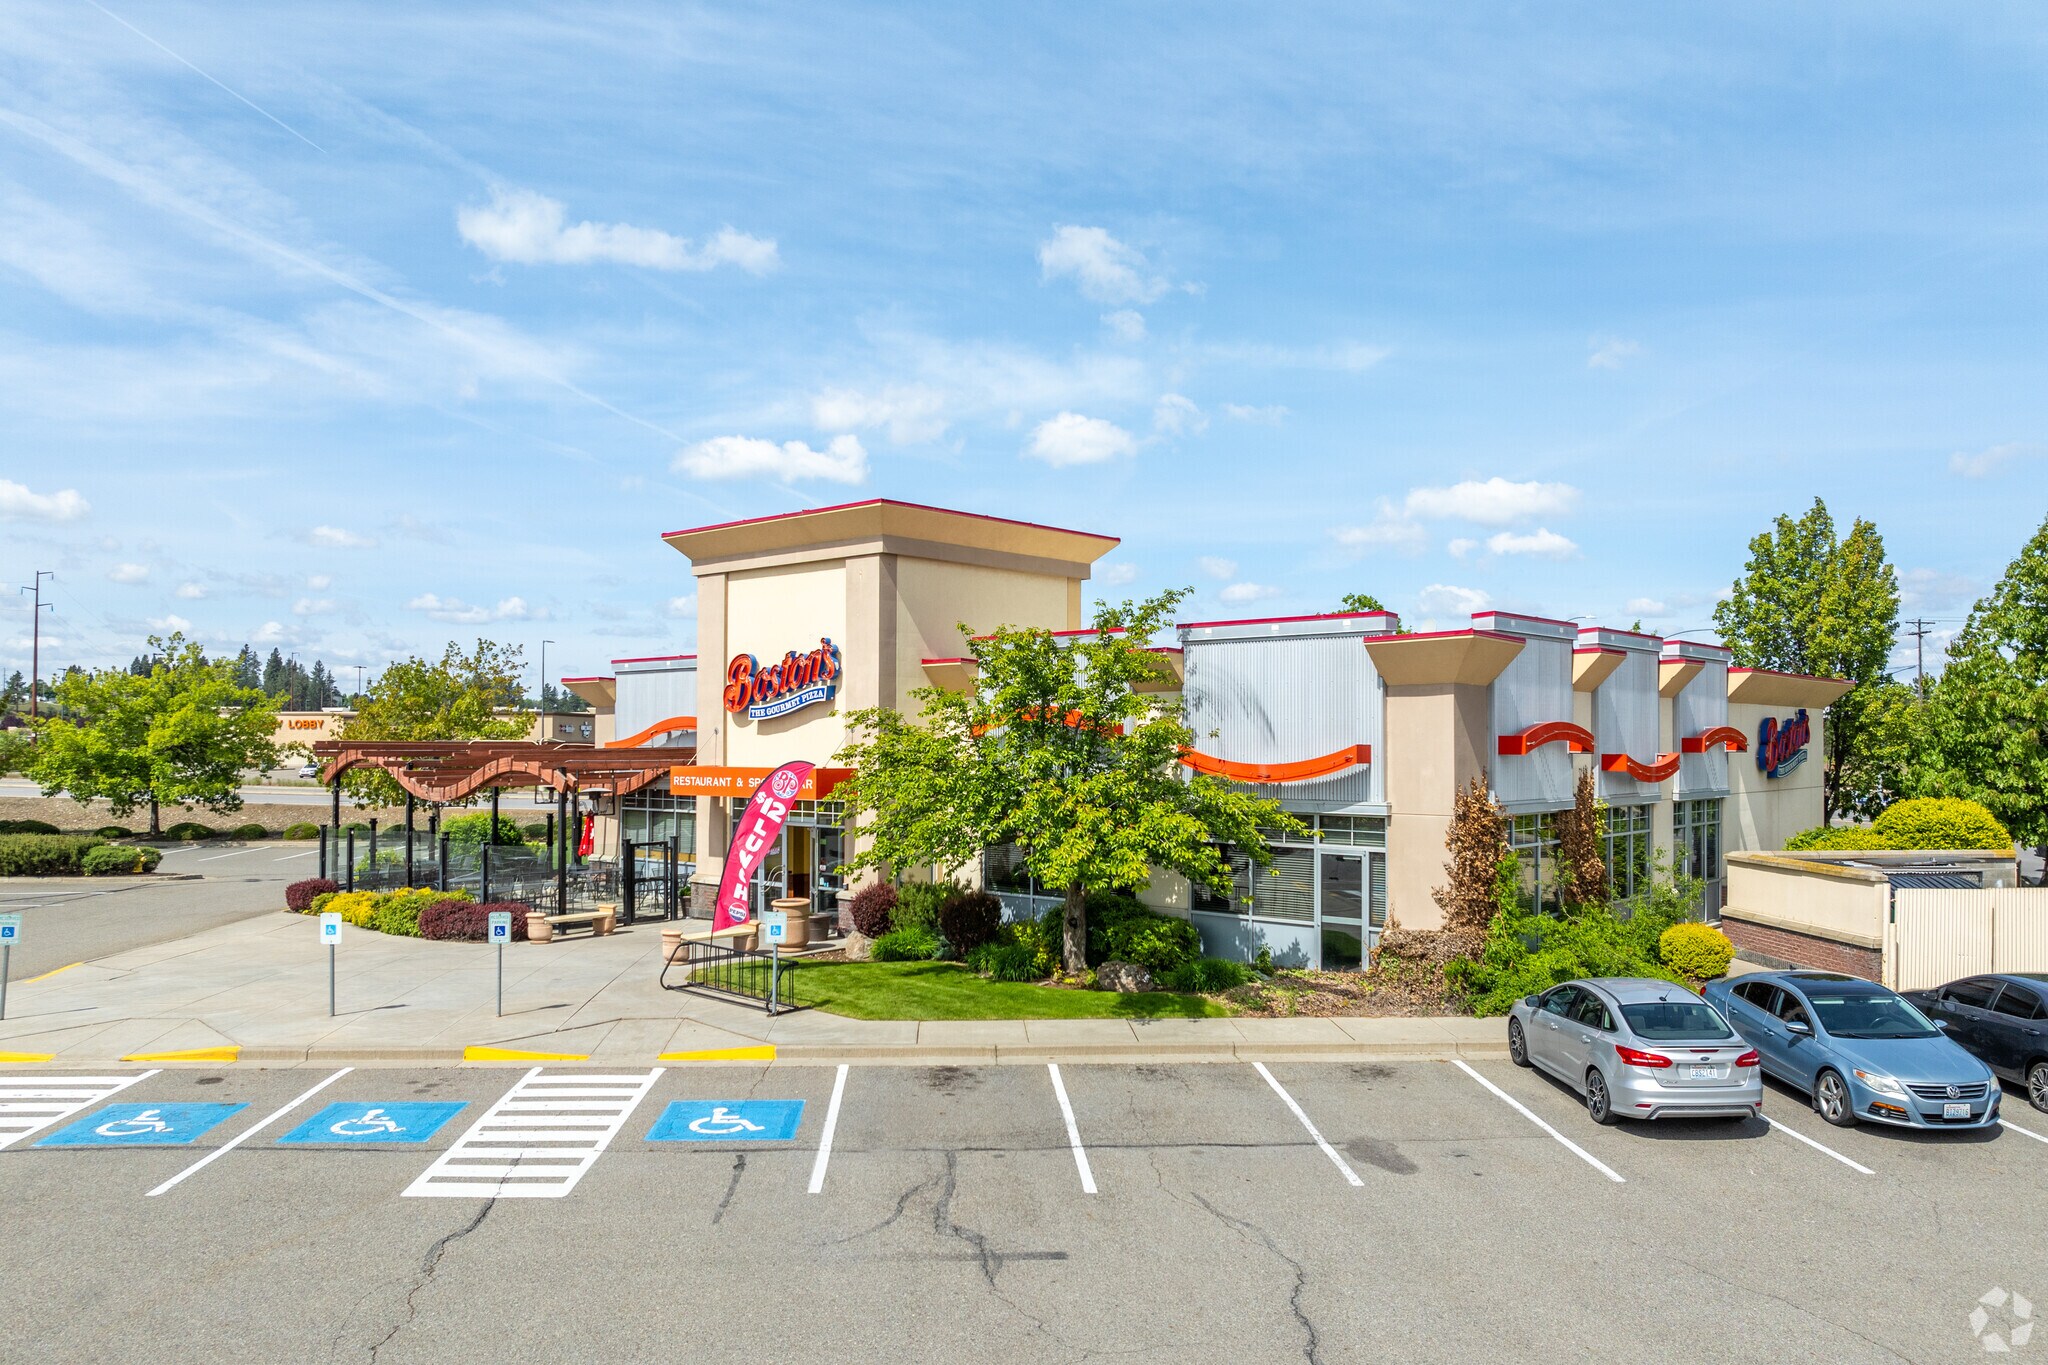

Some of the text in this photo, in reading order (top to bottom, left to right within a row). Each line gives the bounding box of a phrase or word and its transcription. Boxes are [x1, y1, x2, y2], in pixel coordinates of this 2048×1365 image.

[723, 637, 838, 713] Boston's
[750, 690, 824, 717] THE GOURMET PIZZA
[288, 719, 324, 730] LOBBY
[673, 776, 732, 787] RESTAURANT
[736, 778, 743, 787] &
[755, 791, 786, 824] $12
[729, 907, 746, 918] PEPSI
